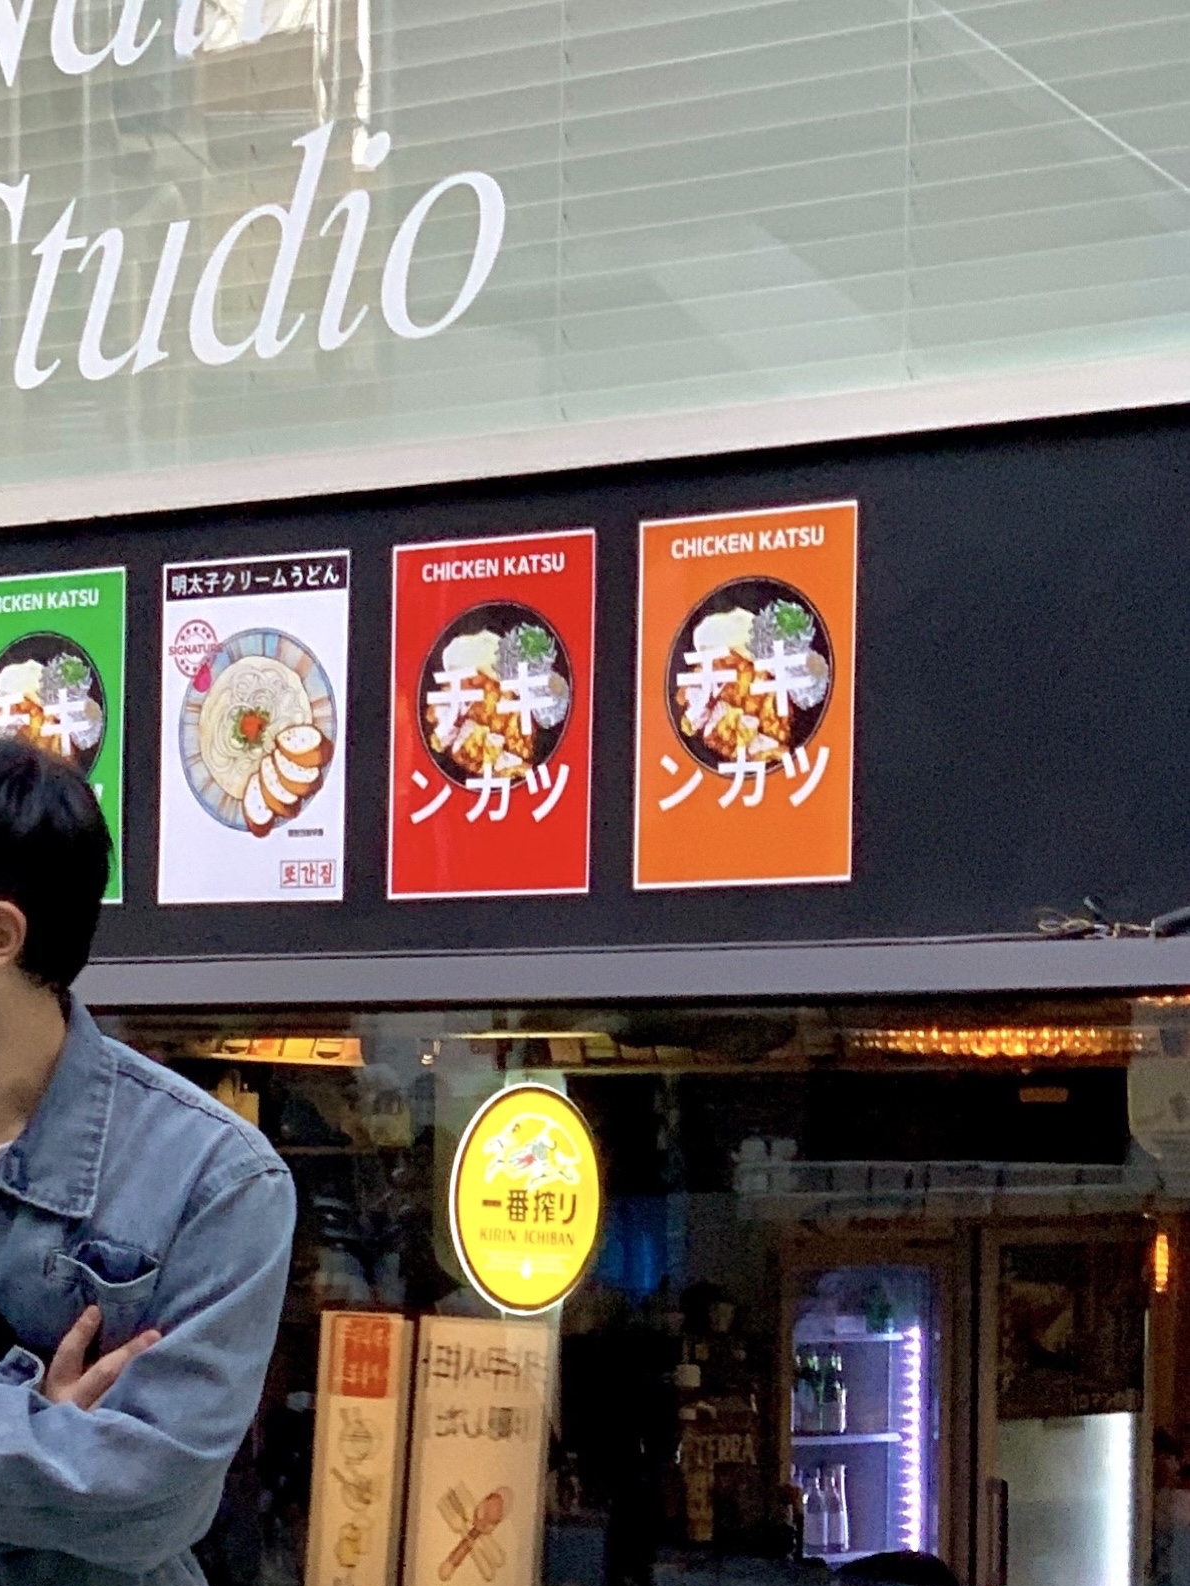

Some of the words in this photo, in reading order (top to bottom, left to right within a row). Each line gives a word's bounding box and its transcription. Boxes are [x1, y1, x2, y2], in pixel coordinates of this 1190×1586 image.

[671, 531, 754, 560] CHICKEN
[758, 525, 825, 550] KATSU
[171, 564, 340, 596] 明太子クリームうどん
[422, 558, 499, 582] CHICKEN
[503, 552, 565, 576] KATSU
[47, 587, 100, 608] KATSU
[410, 762, 570, 824] ンカツ
[658, 746, 830, 811] ンカツ
[482, 1189, 577, 1225] 一番搾り
[479, 1228, 518, 1243] KIRIN
[525, 1229, 575, 1246] ICHIBAN
